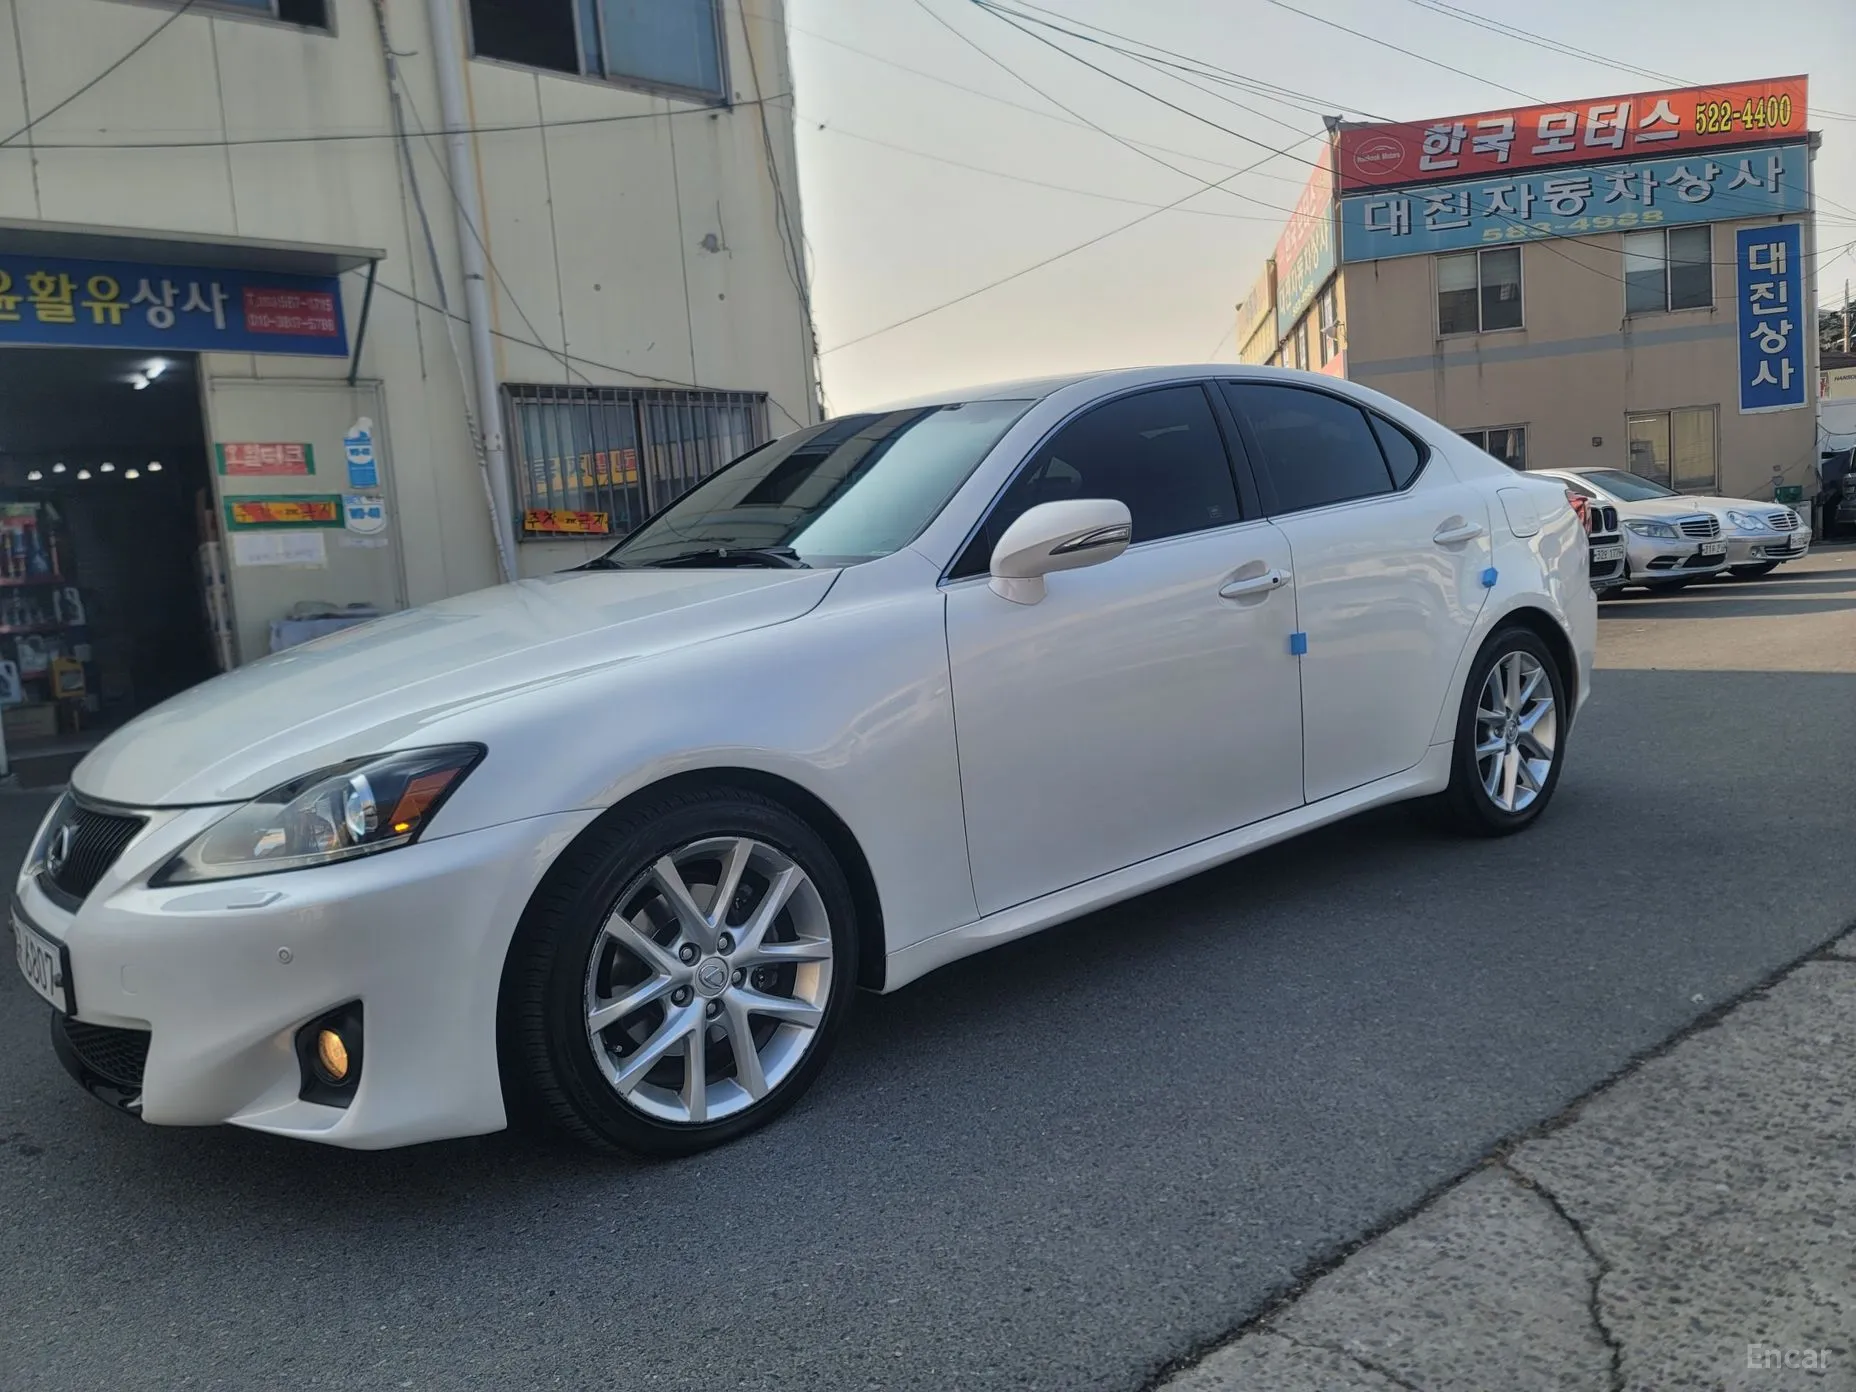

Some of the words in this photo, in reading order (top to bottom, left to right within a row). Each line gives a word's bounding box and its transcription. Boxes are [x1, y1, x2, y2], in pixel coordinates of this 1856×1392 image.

[1419, 116, 1517, 172] 한국
[1531, 99, 1680, 156] 모터스
[1695, 94, 1791, 135] 522-4400
[1364, 156, 1786, 236] 대진자동차상사
[1749, 242, 1794, 390] 대진상사
[25, 934, 54, 997] 6807
